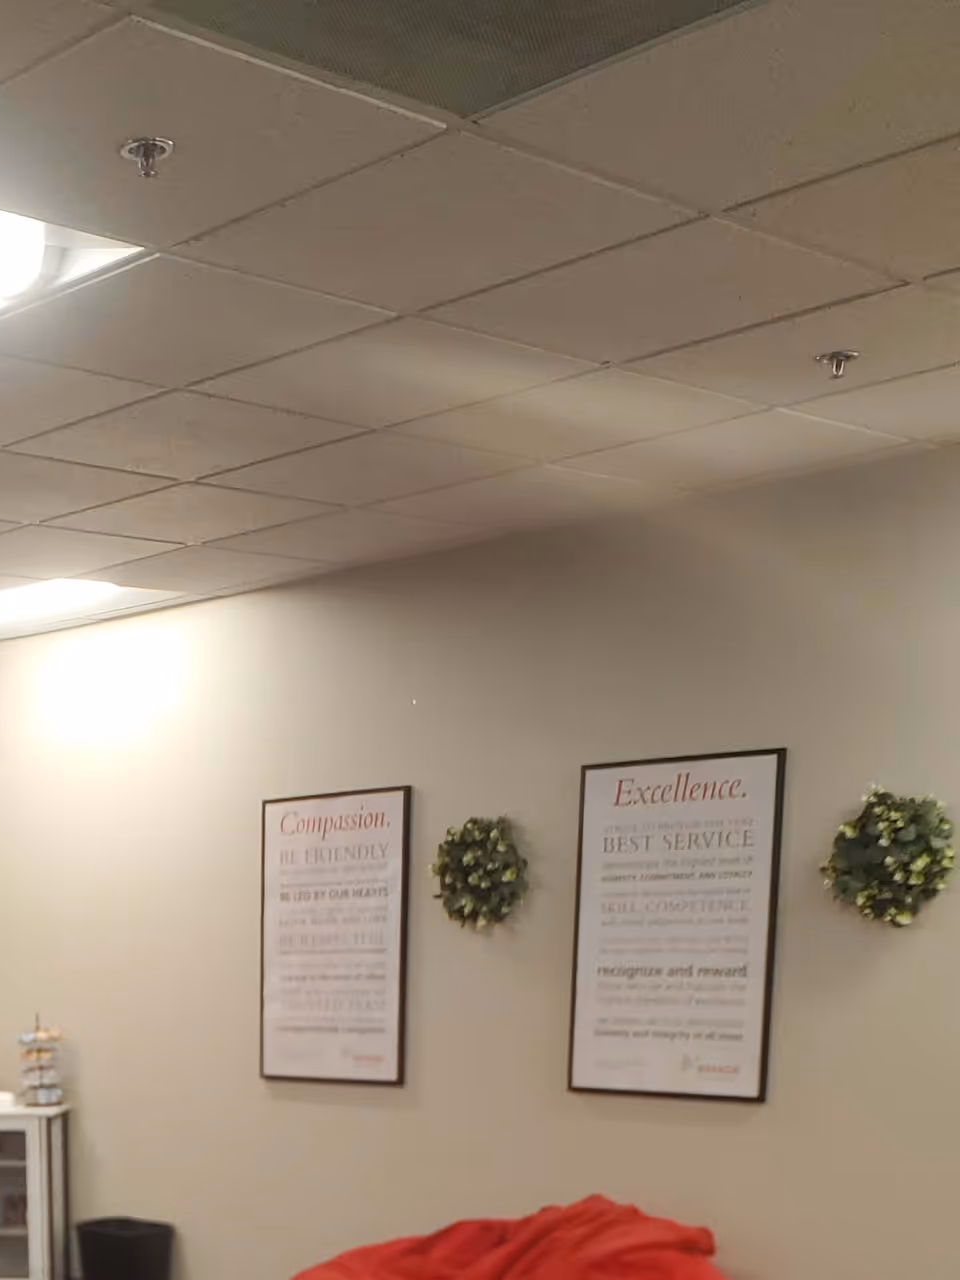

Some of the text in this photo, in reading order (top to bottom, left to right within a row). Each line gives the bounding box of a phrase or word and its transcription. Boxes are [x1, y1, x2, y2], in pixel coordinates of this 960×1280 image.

[613, 772, 747, 807] Excellence.
[280, 804, 391, 841] Compassion.
[603, 830, 754, 853] BEST SERVICE
[597, 964, 748, 980] recognize and reward
